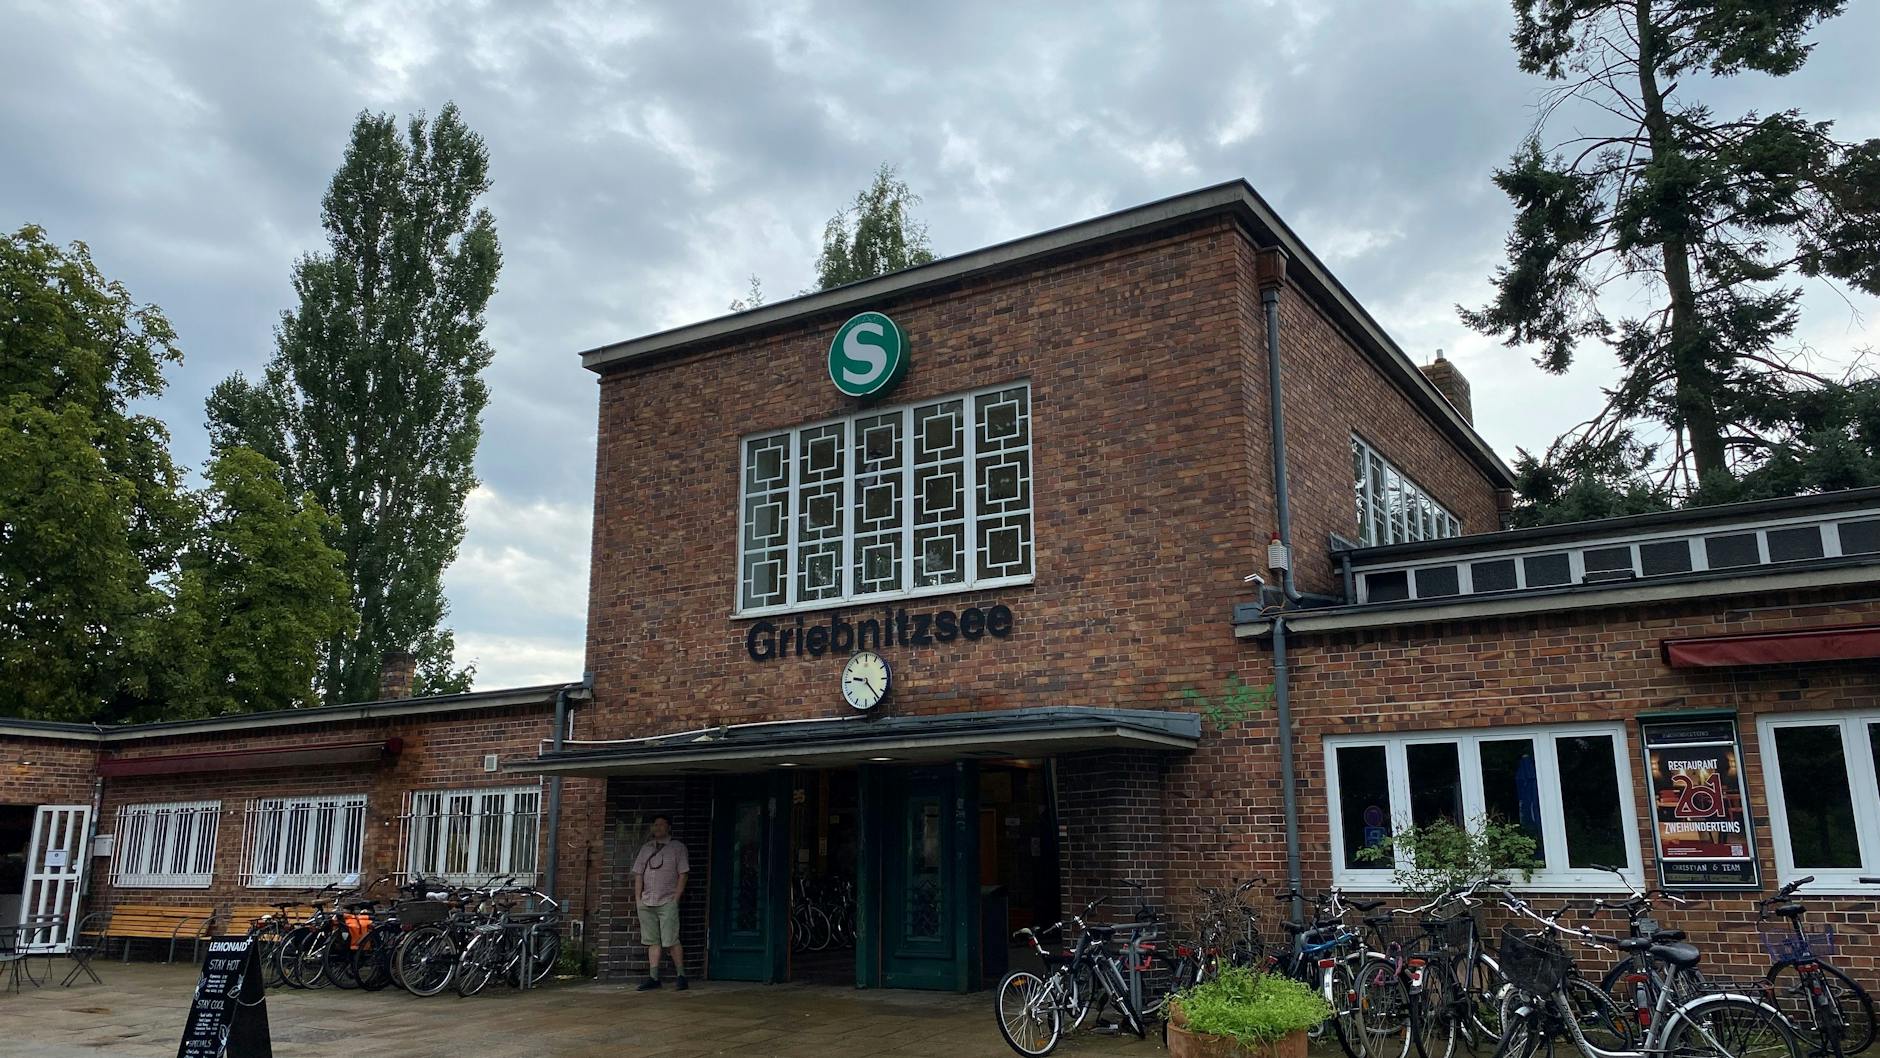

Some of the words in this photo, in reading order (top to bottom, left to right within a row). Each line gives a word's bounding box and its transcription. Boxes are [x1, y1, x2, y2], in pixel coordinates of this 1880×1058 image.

[843, 322, 887, 385] S
[748, 604, 1013, 661] Griebnitzsee
[1668, 759, 1718, 771] RESTAURANT
[1672, 773, 1725, 818] 201
[1664, 821, 1741, 834] ZWEIHUNDERTEINS
[1722, 864, 1741, 872] TEAM
[209, 960, 226, 970] STAY
[227, 960, 241, 970] HOT
[196, 1000, 209, 1009] STAY
[211, 1000, 224, 1010] COOL
